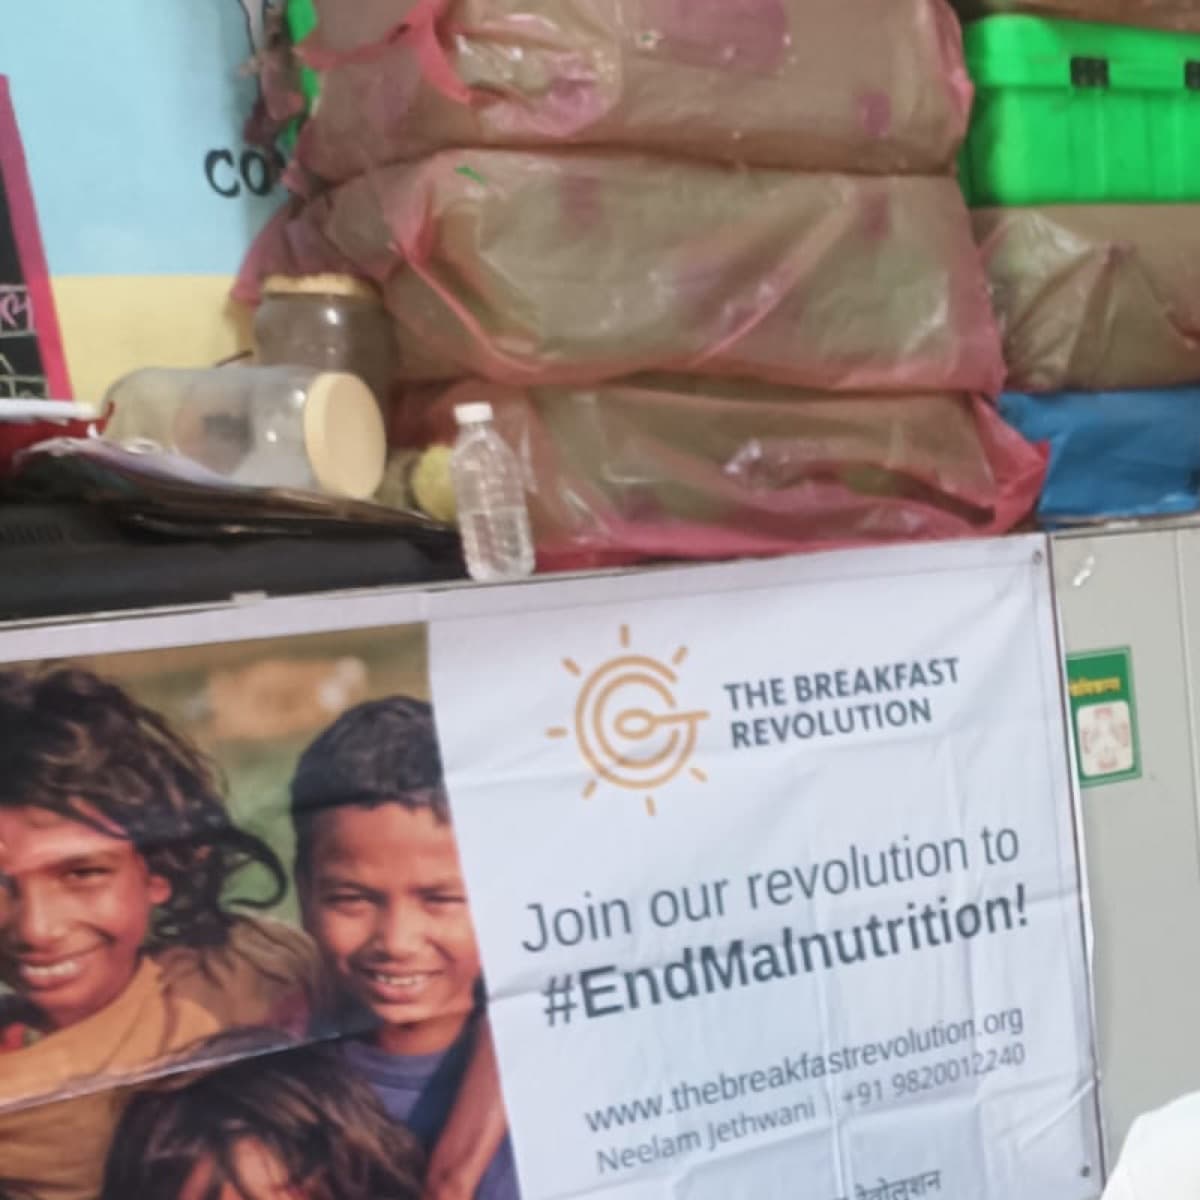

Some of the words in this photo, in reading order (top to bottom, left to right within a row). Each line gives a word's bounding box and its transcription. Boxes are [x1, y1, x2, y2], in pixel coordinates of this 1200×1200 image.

[723, 677, 787, 711] THE
[794, 657, 960, 704] BREAKFAST
[730, 698, 933, 750] REVOLUTION
[522, 890, 632, 953] Join
[650, 877, 729, 928] our
[746, 833, 969, 910] revolution
[980, 825, 1020, 867] to
[541, 882, 1028, 1027] #EndMalnutrition!
[584, 1006, 1025, 1133] www.thebreakfastrevolution.org
[596, 1130, 701, 1174] Neelam
[706, 1094, 816, 1152] Jethwani
[842, 1078, 883, 1106] +91
[891, 1041, 1026, 1098] 9820012240
